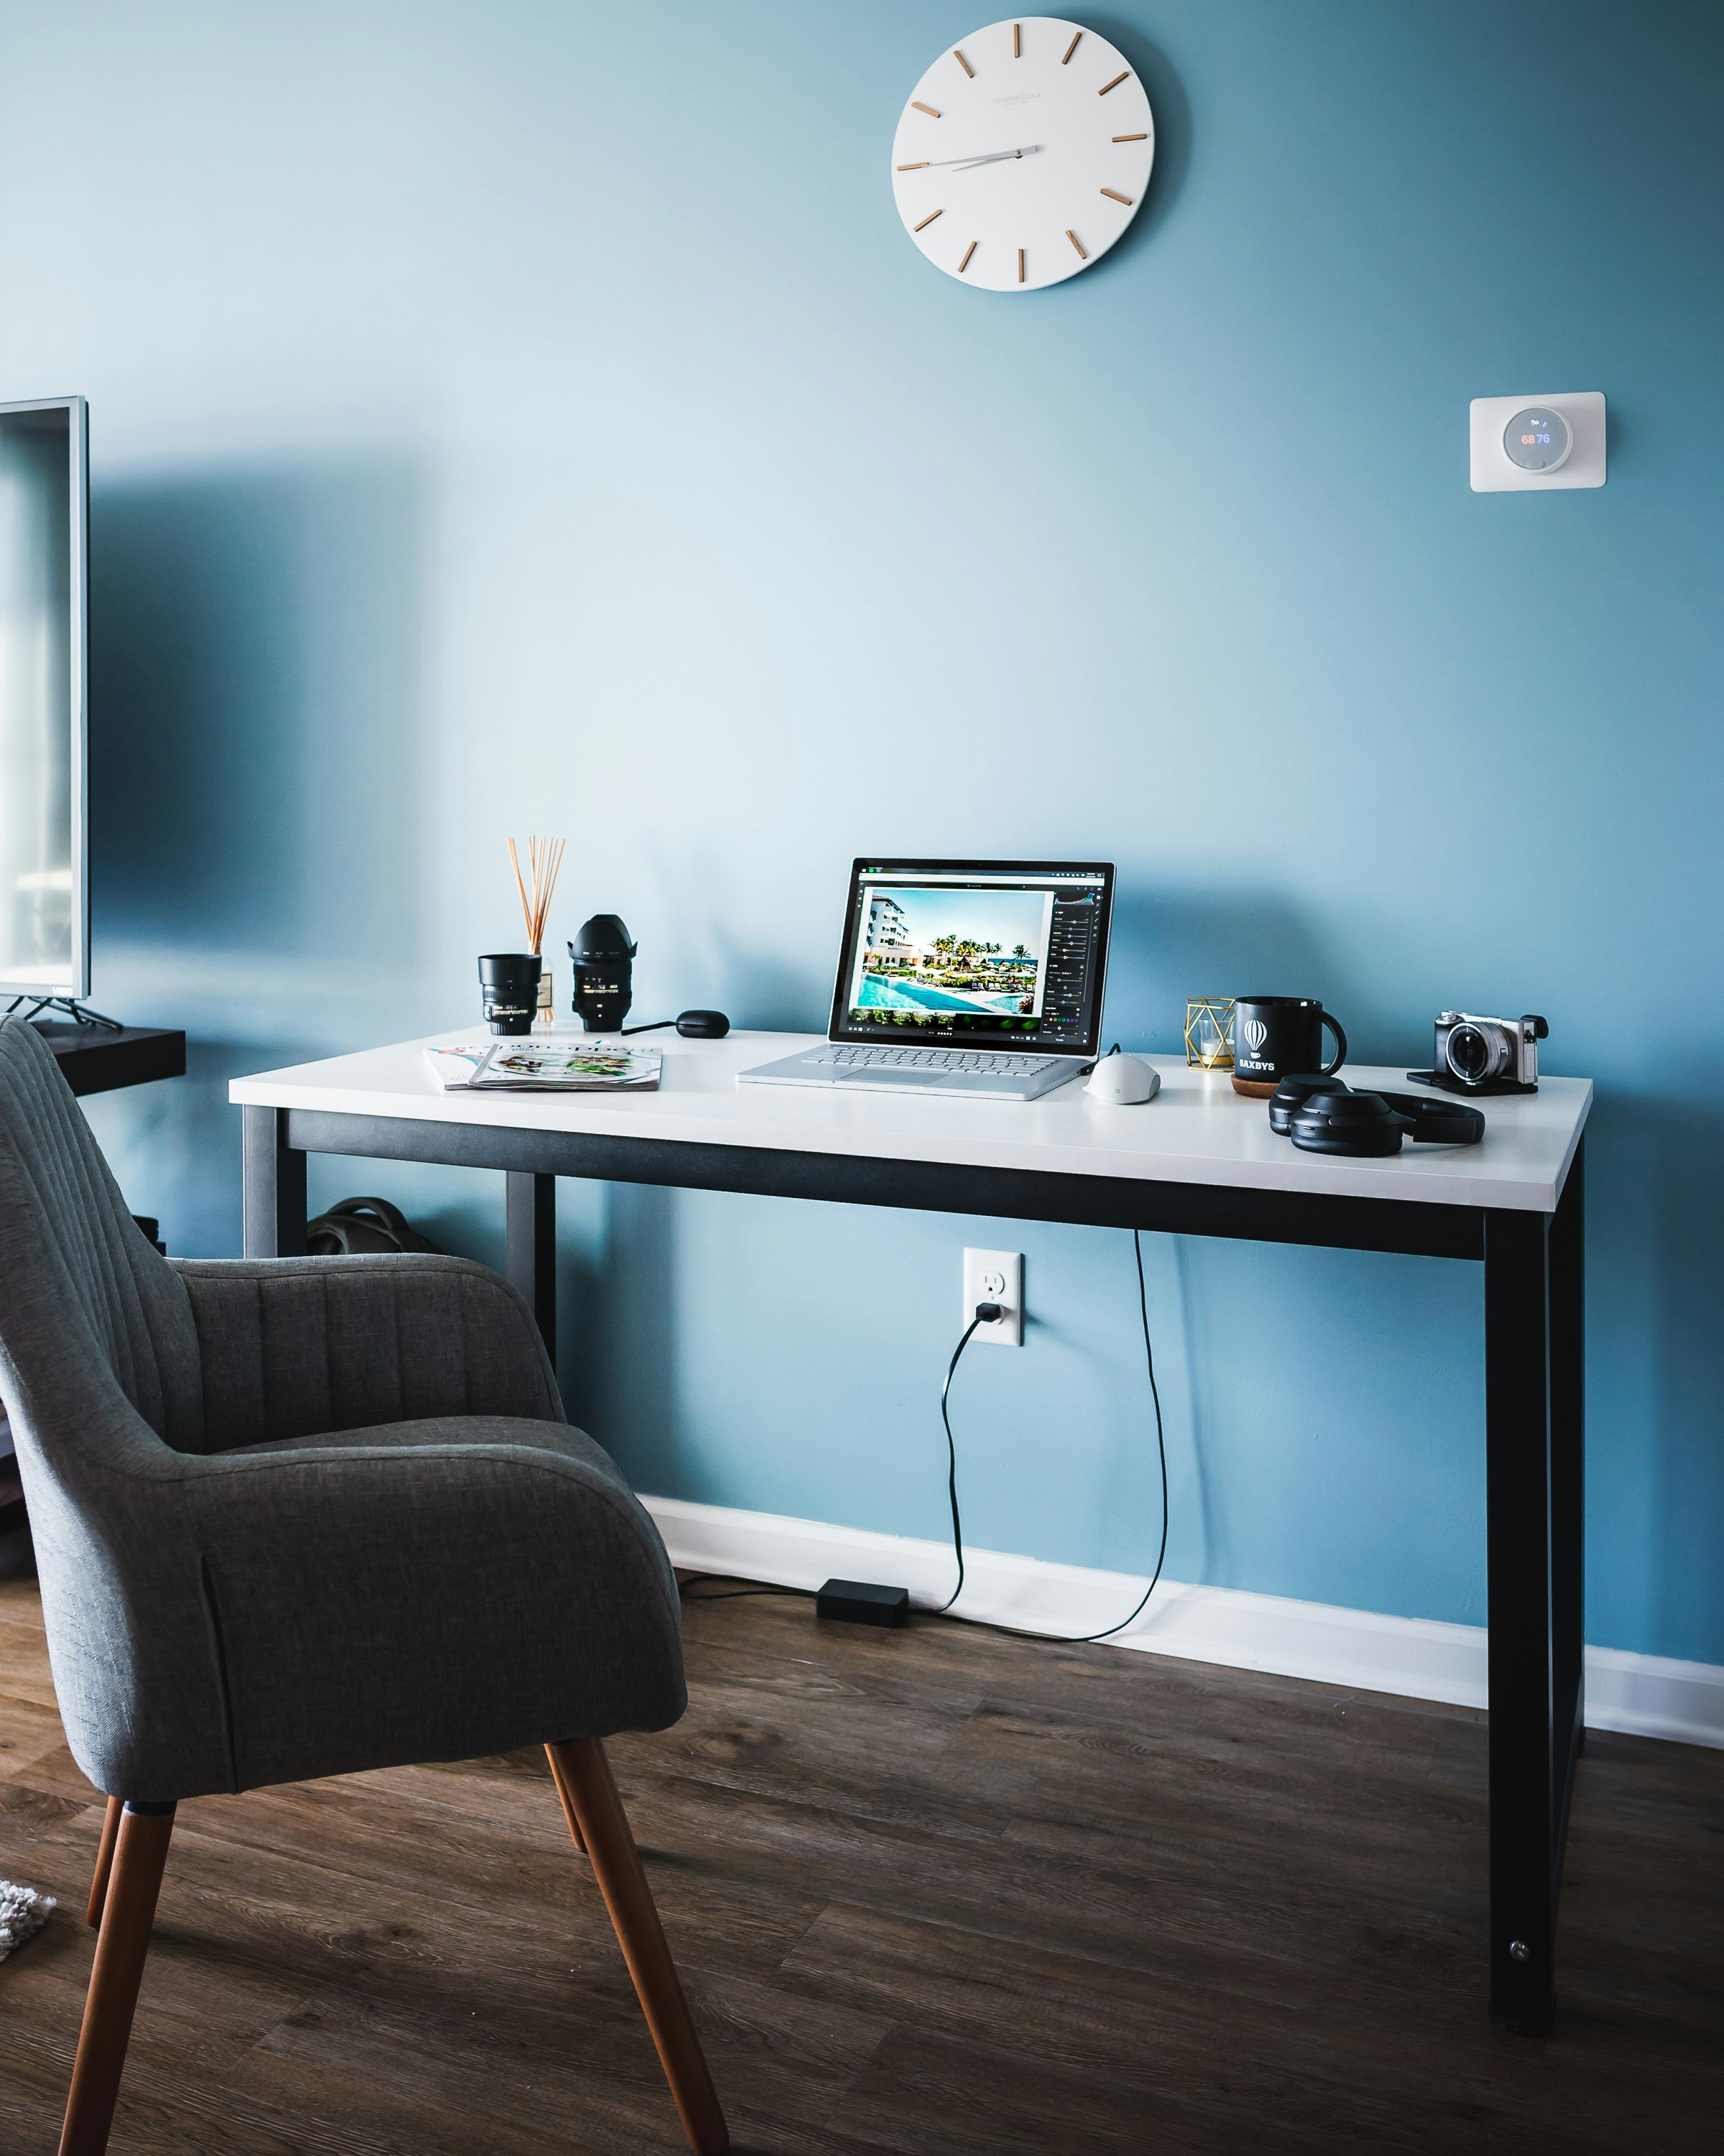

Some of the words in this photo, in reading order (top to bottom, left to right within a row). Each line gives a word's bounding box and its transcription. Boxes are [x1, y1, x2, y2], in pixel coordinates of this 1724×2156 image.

[1521, 435, 1535, 444] 68
[1536, 433, 1550, 444] 76
[1239, 1059, 1275, 1071] SAXBYS
